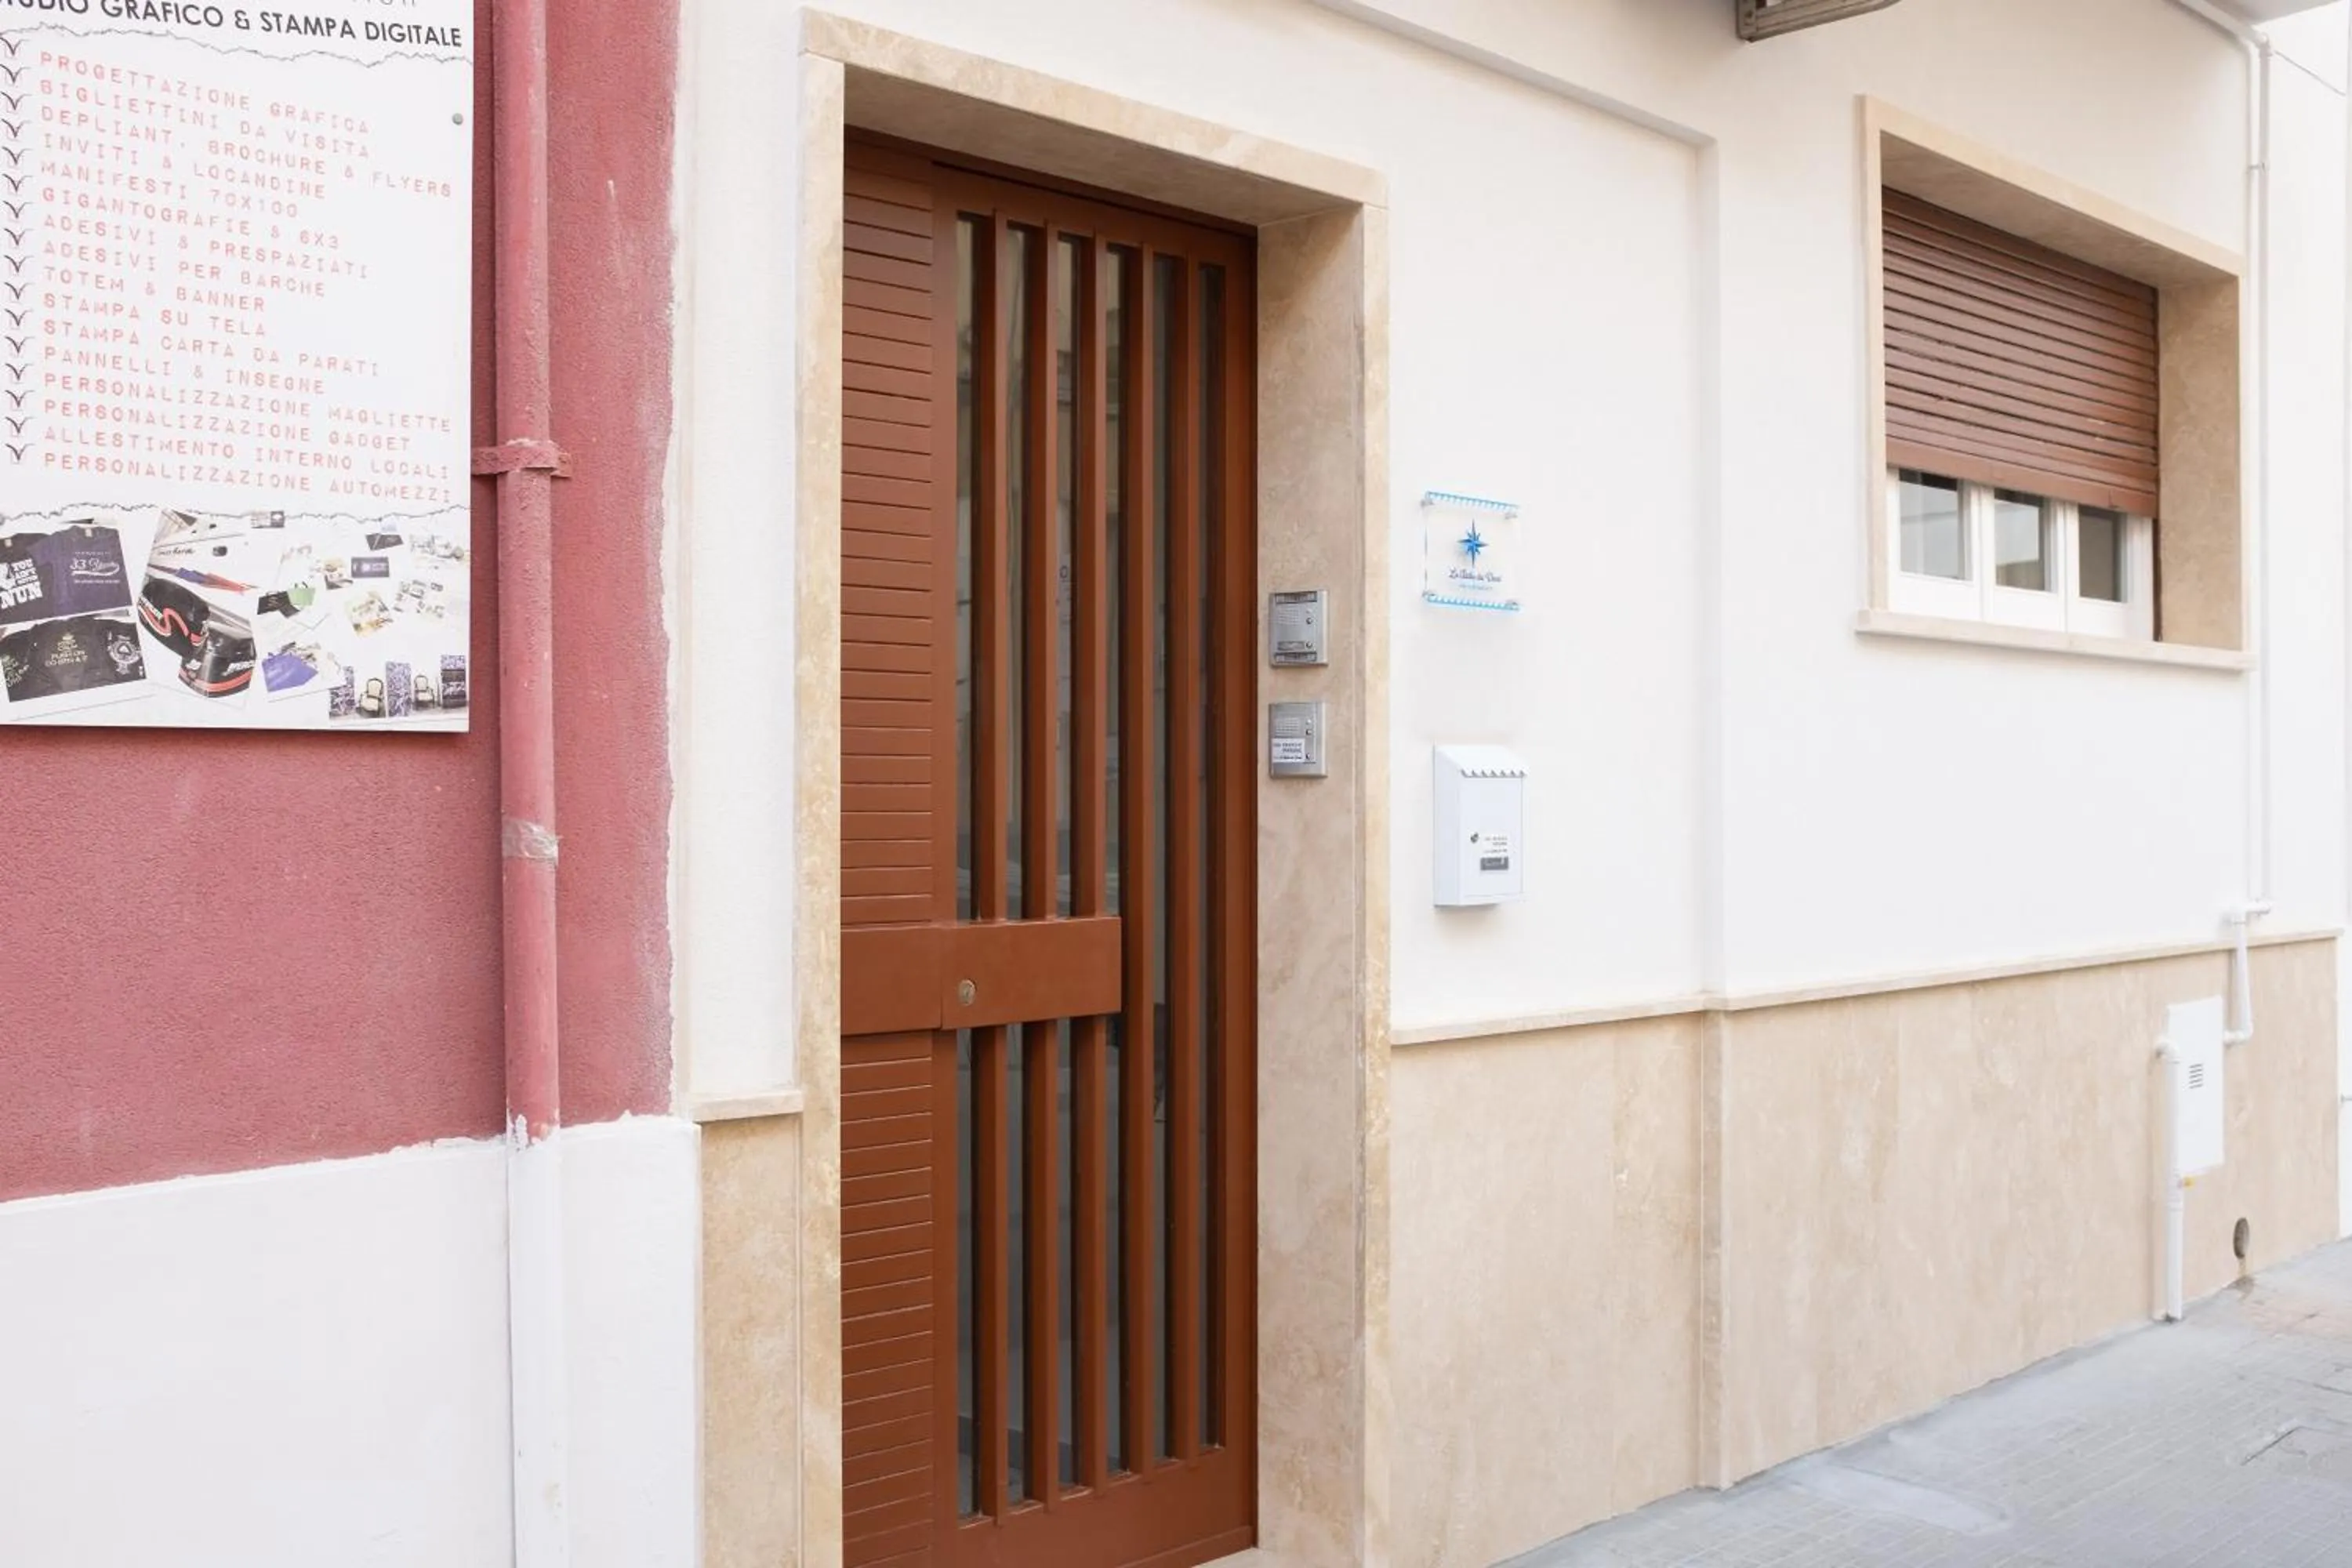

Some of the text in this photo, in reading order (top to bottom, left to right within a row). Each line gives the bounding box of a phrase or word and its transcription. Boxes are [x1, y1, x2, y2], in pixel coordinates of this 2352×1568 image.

[101, 0, 223, 27] GRAFICO
[234, 9, 250, 30] &
[260, 12, 356, 38] STAMPA
[365, 21, 462, 47] DIGITALE
[40, 51, 369, 134] PROGETTAZIONE GRAFICA
[40, 79, 369, 158] BIGLIETTINI DA VISITA
[40, 162, 187, 200] MANIFESTI
[44, 133, 138, 165] INVITI
[194, 161, 325, 199] LOCANDINE
[208, 140, 325, 174] BROCHURE
[372, 171, 452, 198] FLYERS
[42, 187, 250, 236] GIGANTOGRAFIE
[299, 230, 339, 249] 6X3
[43, 214, 155, 245] ADESIVI
[209, 239, 367, 279] PRESPAZIATI
[43, 240, 325, 297] ADESIVI PER BARCHE
[43, 265, 124, 293] TOTEM
[176, 285, 265, 312] BANNER
[43, 292, 266, 336] STAMPA SU TELA
[43, 318, 379, 377] STAMPA CARTA DA PARATI
[44, 346, 171, 376] PANNELLI
[226, 368, 325, 394] INSEGNE
[44, 372, 450, 432] PERSONALIZZAZIONE MAGLIETTE
[44, 399, 410, 451] PERSONALIZZAZIONE GADGET
[44, 426, 448, 480] ALLESTIMENTO INTERNO LOCALI
[44, 452, 450, 503] PERSONALIZZAZIONE AUTOMEZZI
